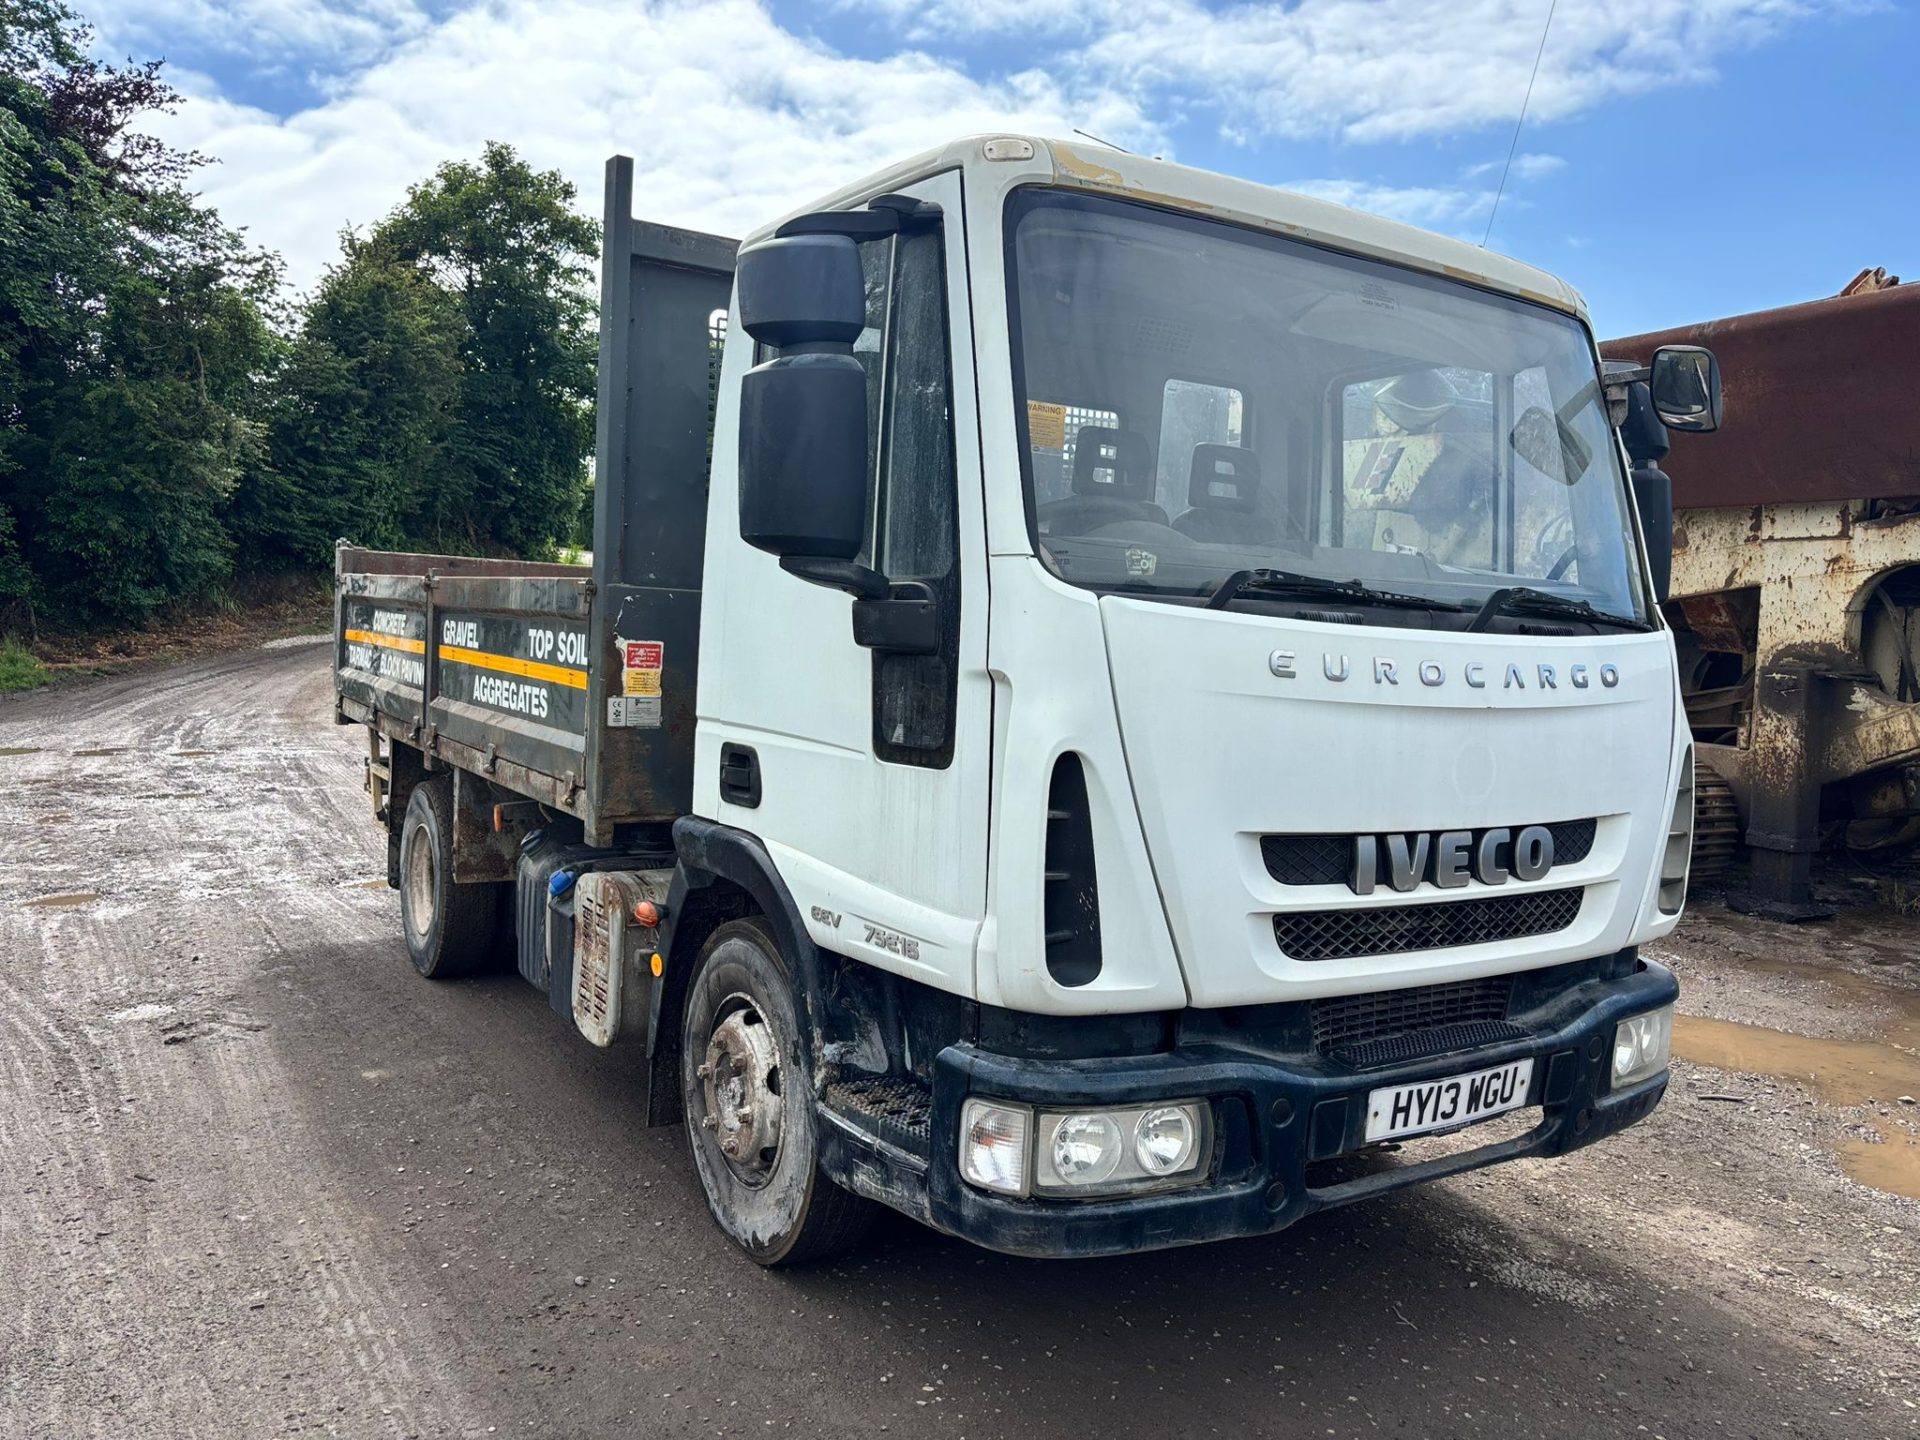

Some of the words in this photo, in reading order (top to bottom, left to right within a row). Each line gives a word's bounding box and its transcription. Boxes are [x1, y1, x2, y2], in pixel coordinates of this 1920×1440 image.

[373, 608, 406, 636] CONCRETE
[443, 619, 479, 649] GRAVEL
[380, 653, 401, 679] BLOCK
[528, 628, 554, 660] TOP
[557, 631, 588, 666] SOIL
[1268, 649, 1620, 690] EUROCARGO
[473, 674, 549, 719] AGGREGATES
[1348, 825, 1555, 896] IVECO
[810, 904, 842, 929] EEV
[1390, 1082, 1461, 1130] HY13
[1466, 1066, 1519, 1114] WGU
